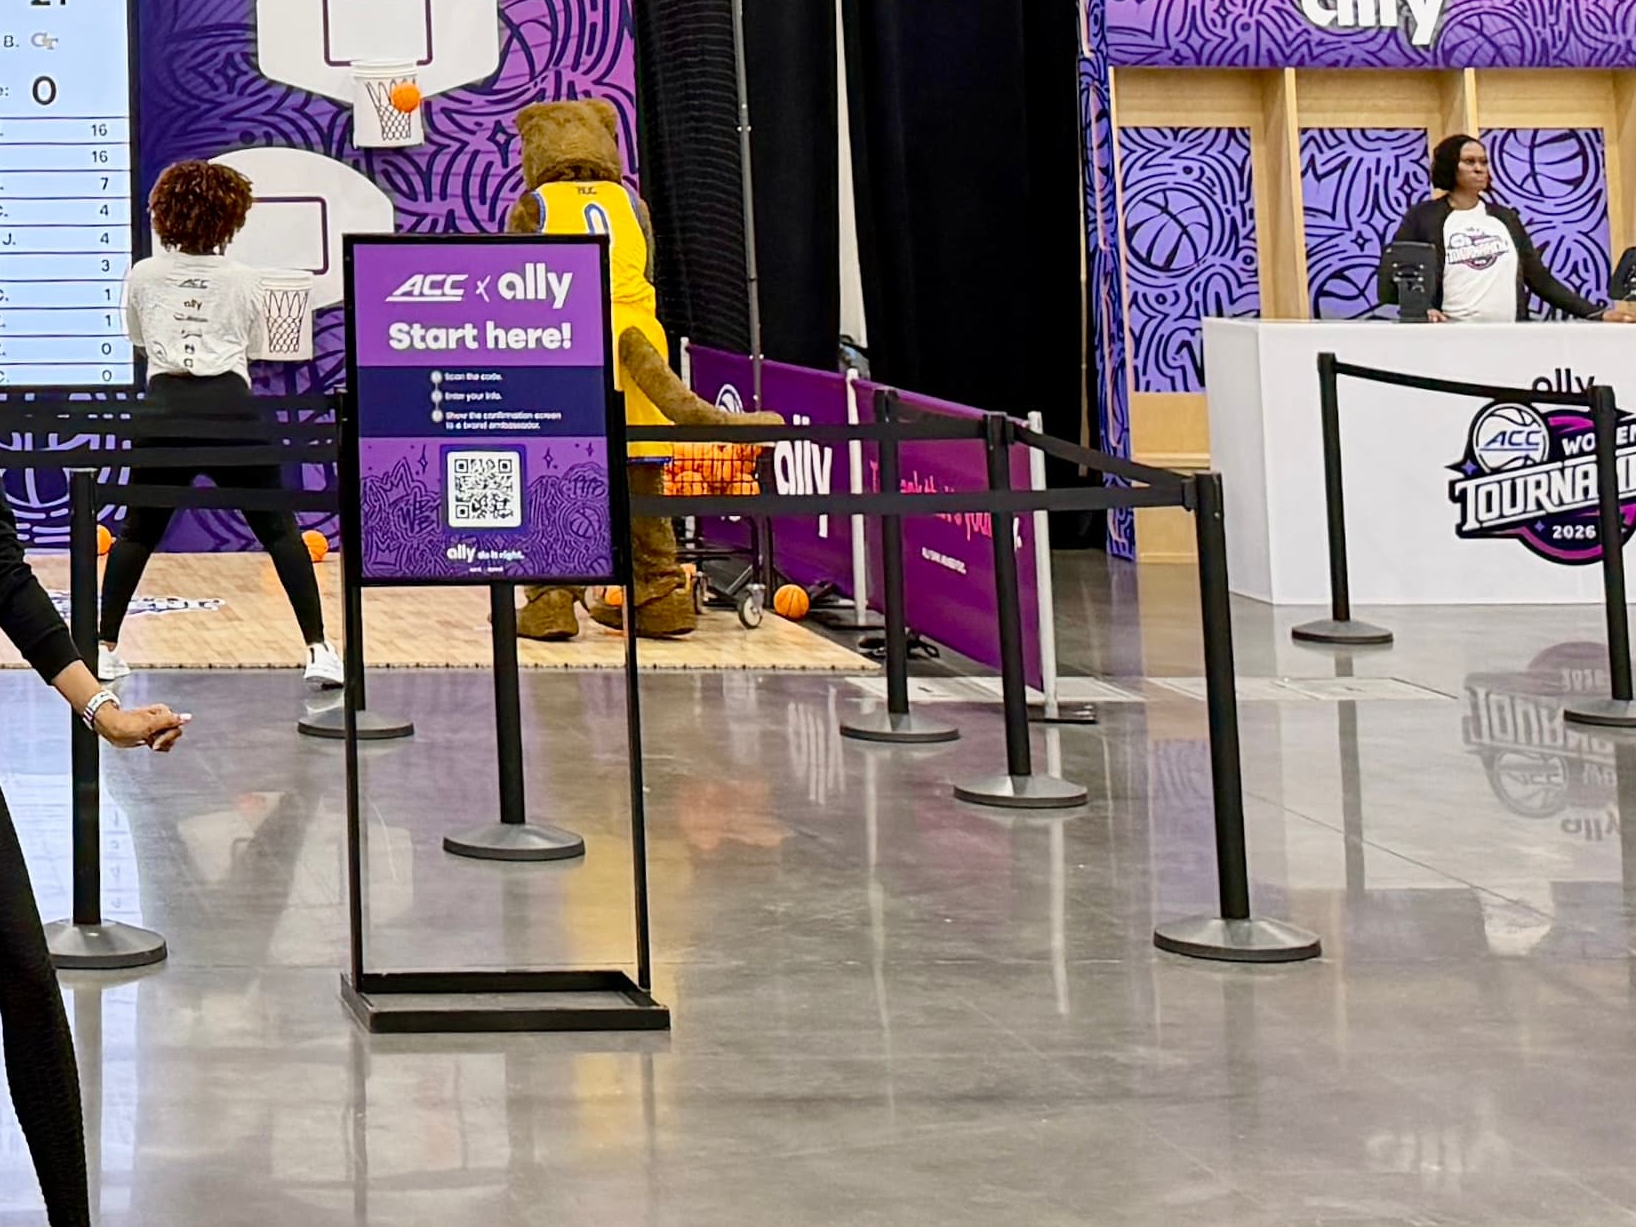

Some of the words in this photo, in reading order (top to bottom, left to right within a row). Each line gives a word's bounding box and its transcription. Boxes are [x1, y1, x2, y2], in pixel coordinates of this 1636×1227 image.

[3, 35, 20, 48] B.
[32, 76, 57, 105] 0
[91, 124, 108, 137] 16
[92, 151, 108, 163] 16
[100, 178, 109, 191] 7
[99, 204, 109, 217] 4
[1, 233, 16, 246] J.
[99, 233, 110, 245] 4
[101, 259, 110, 272] 3
[389, 274, 469, 300] ACC
[498, 263, 573, 310] ally
[104, 288, 112, 301] 1
[104, 315, 112, 327] 1
[388, 322, 480, 350] Start
[485, 321, 573, 350] here!
[101, 343, 112, 355] 0
[102, 371, 112, 382] 0
[1483, 429, 1543, 449] ACC
[1551, 524, 1597, 540] 2026
[446, 543, 477, 564] ally
